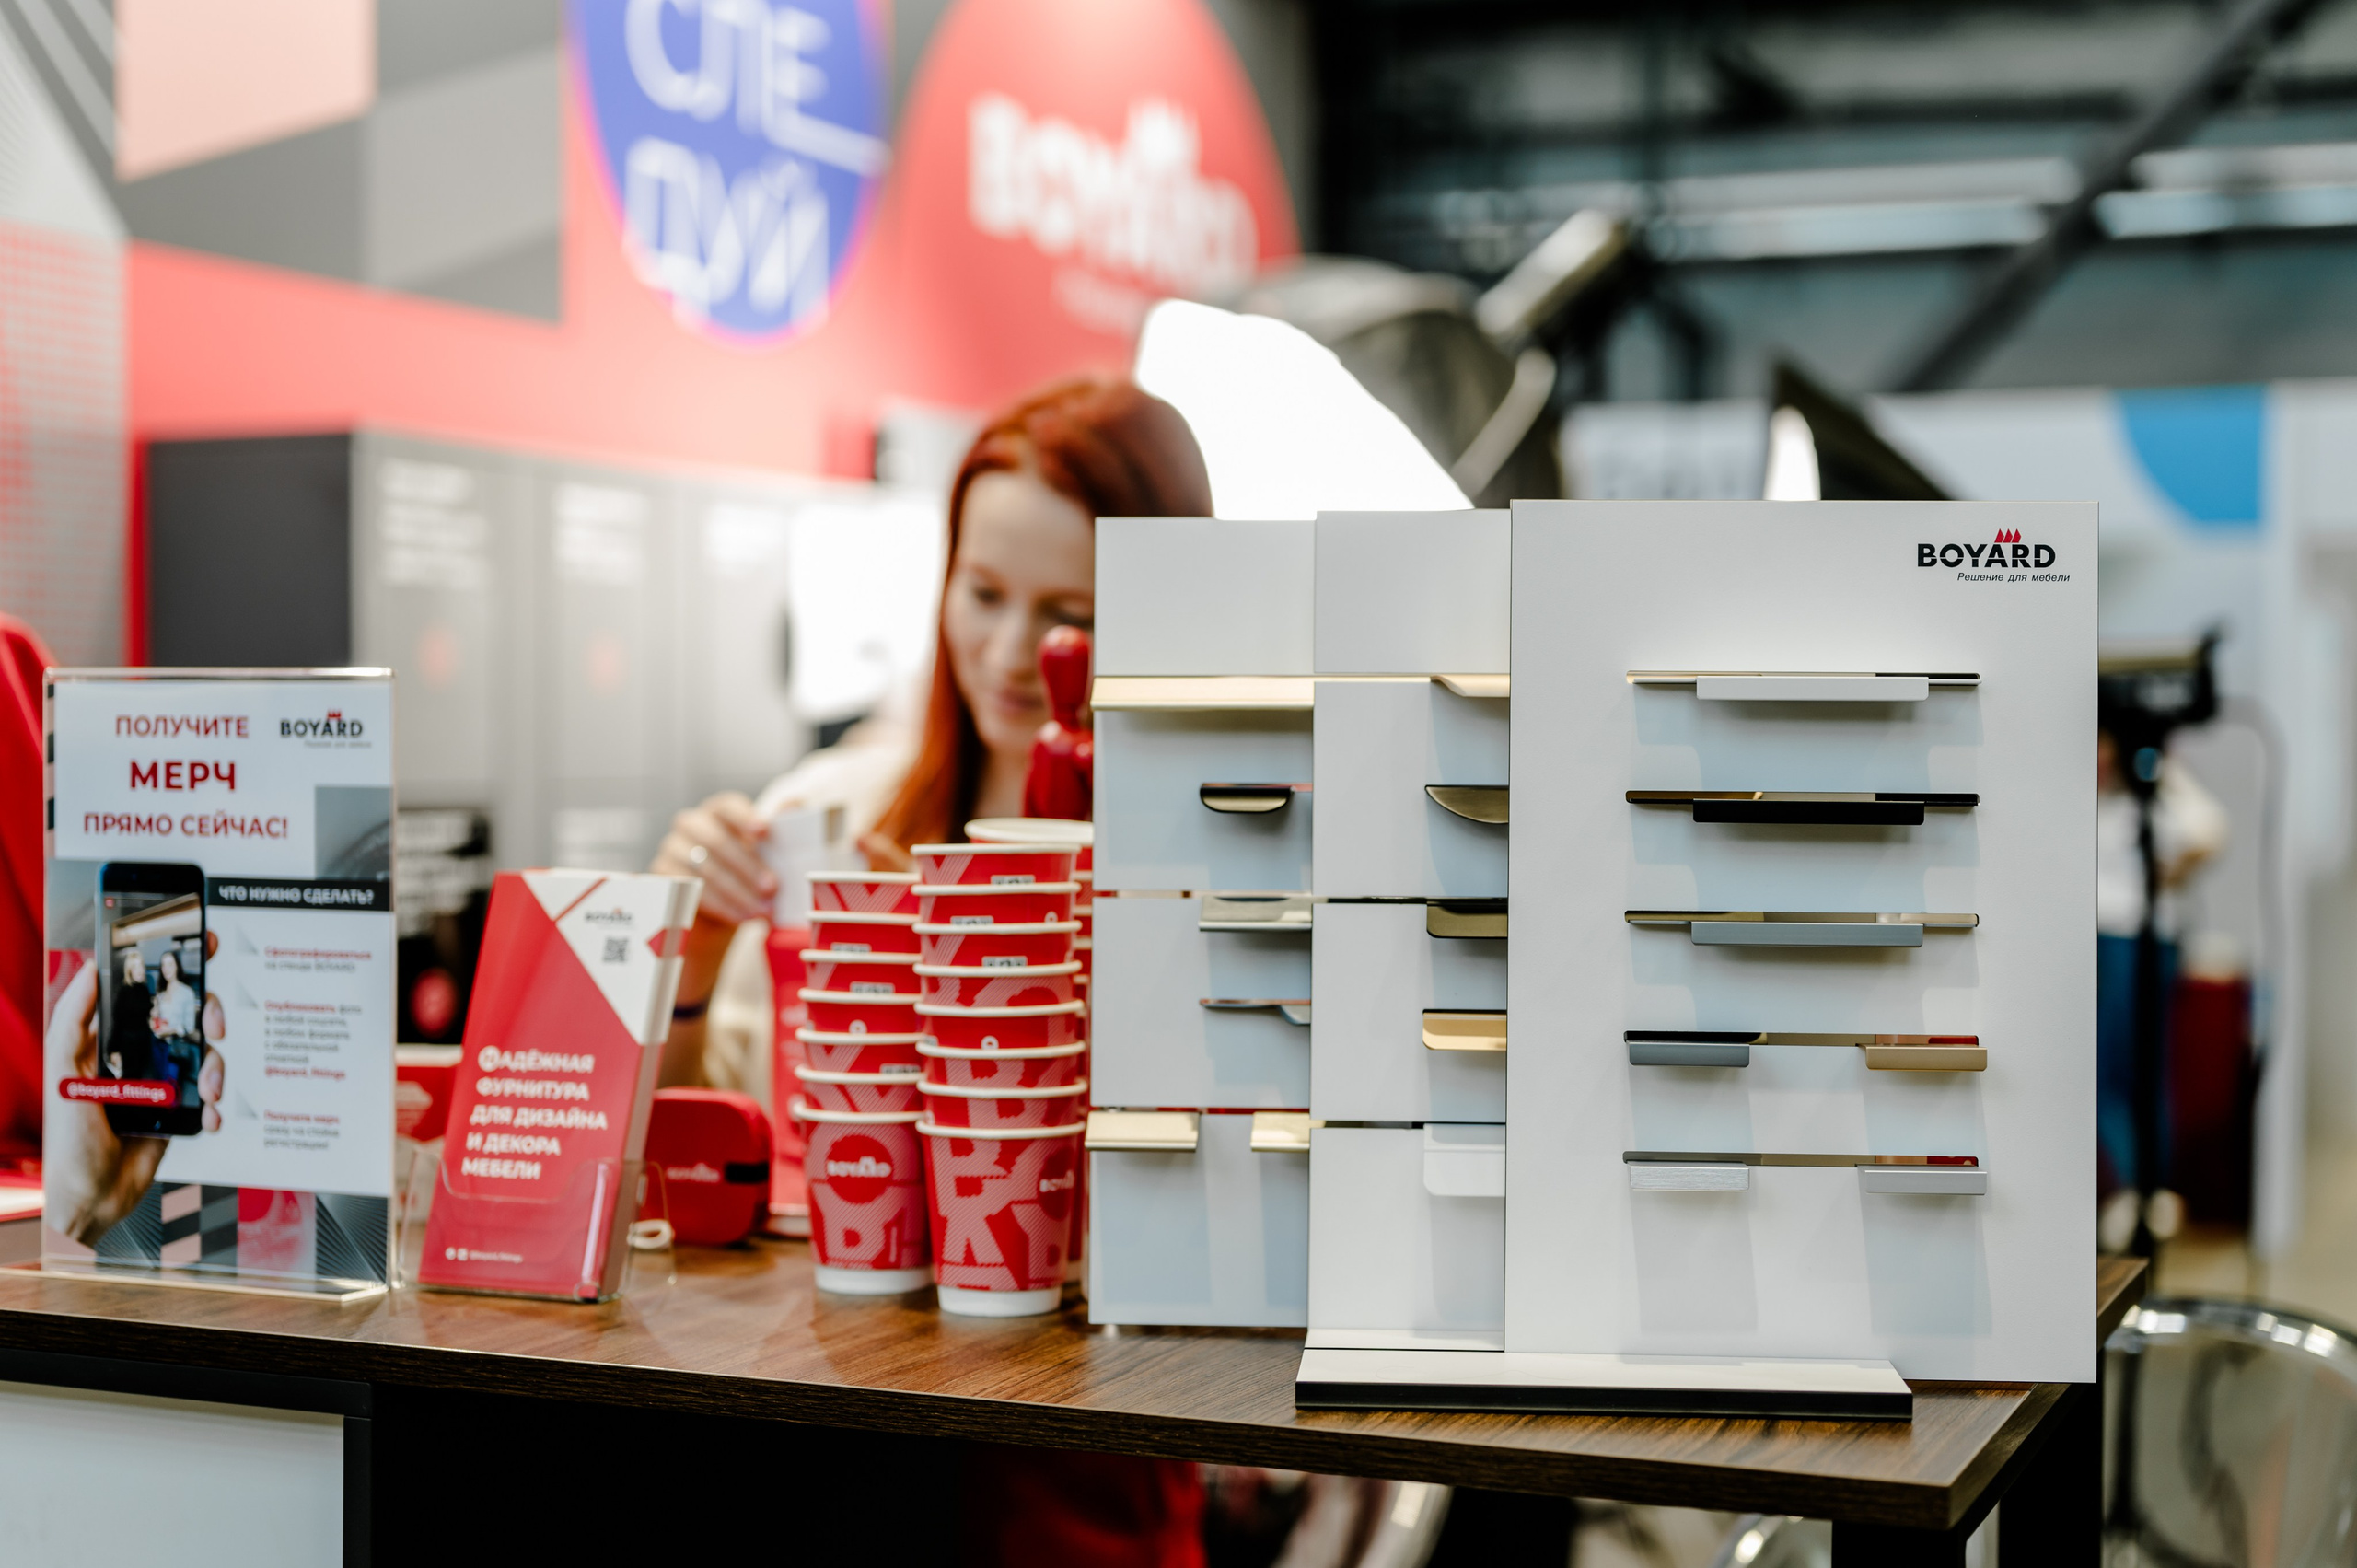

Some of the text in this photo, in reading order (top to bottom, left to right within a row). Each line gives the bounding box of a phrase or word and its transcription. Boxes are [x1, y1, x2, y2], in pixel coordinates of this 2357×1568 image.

[1917, 543, 2056, 568] BOYARD
[1957, 572, 2071, 583] Решение для мебели
[115, 715, 249, 738] ПОЛУЧИТЕ
[280, 719, 363, 737] BOYARD
[130, 761, 236, 790] МЕРЧ
[84, 809, 288, 838] ПРЯМО СЕЙЧАС!
[218, 885, 375, 905] ЧТО НУЖНО СДЕЛАТЬ?
[476, 1076, 590, 1101] ФУРНИТУРА
[469, 1104, 609, 1131] ДЛЯ ДИЗАЙНА
[465, 1132, 562, 1156] И ДЕКОРА
[460, 1156, 542, 1180] МЕБЕЛИ
